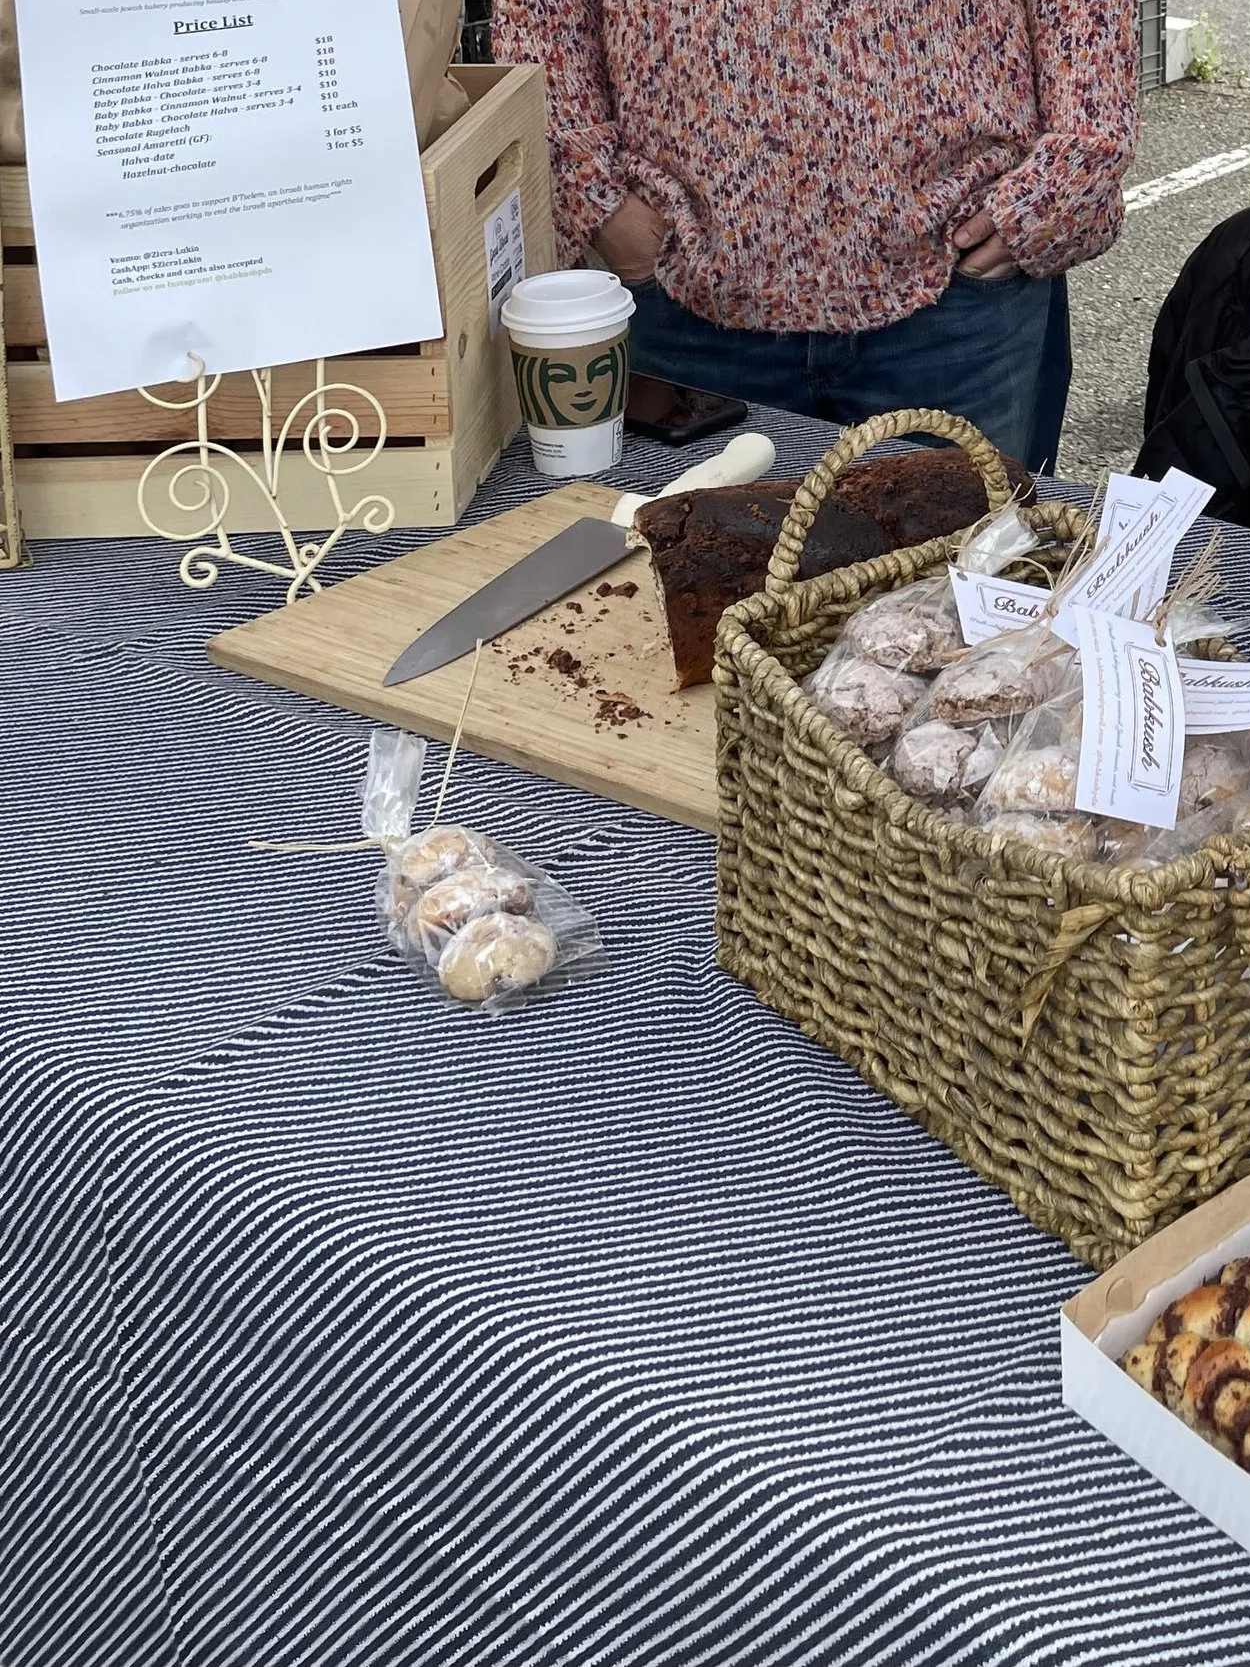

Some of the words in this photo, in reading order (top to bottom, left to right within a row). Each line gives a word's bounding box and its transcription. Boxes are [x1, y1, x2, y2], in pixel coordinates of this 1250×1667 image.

[169, 0, 205, 9] producing
[173, 17, 218, 33] Price
[223, 14, 254, 27] List
[315, 35, 333, 44] $18
[91, 61, 139, 72] Chocolate
[141, 57, 172, 67] Babka
[179, 54, 210, 63] serves
[212, 49, 229, 58] 6-8
[316, 47, 334, 56] $18
[92, 73, 142, 85] Cinnamon
[145, 68, 179, 78] Walnut
[181, 64, 212, 74] Babka
[220, 59, 250, 68] serves
[252, 56, 268, 65] 6-8
[317, 58, 335, 67] $18
[93, 84, 141, 97] Chocolate
[142, 81, 171, 91] Halva
[173, 76, 204, 86] Babka
[212, 71, 242, 81] serves
[244, 68, 261, 77] 6-8
[318, 69, 337, 78] $10
[94, 98, 118, 108] Baby
[121, 95, 152, 105] Babka
[160, 88, 206, 100] Chocolate
[213, 82, 243, 92] serves
[245, 79, 261, 88] 3-4
[319, 80, 338, 89] $10
[94, 110, 119, 120] Baby
[121, 107, 152, 117] Babka
[160, 99, 209, 111] Cinnamon
[212, 93, 246, 104] Walnut
[254, 88, 284, 98] serves
[286, 85, 302, 94] 3-4
[321, 91, 339, 101] $10
[95, 122, 120, 132] Baby
[122, 119, 153, 129] Babka
[161, 111, 208, 123] Chocolate
[210, 105, 238, 116] Halva
[246, 101, 276, 111] serves
[278, 98, 294, 107] 3-4
[322, 104, 333, 113] $1
[335, 100, 358, 111] each
[96, 132, 143, 144] Chocolate
[146, 124, 191, 137] Rugelach
[325, 129, 331, 138] 3
[333, 126, 348, 136] for
[349, 125, 362, 134] $5
[97, 144, 141, 157] Seasonal
[143, 137, 186, 151] Amaretti
[189, 133, 213, 146] (GF):
[327, 142, 333, 151] 3
[335, 140, 349, 149] for
[351, 138, 364, 147] $5
[121, 152, 175, 166] Halva-date
[122, 160, 217, 180] Hazelnut-chocolate
[144, 206, 152, 215] of
[153, 205, 172, 213] sales
[173, 203, 190, 212] goes
[201, 197, 230, 208] support
[304, 181, 329, 191] human
[331, 178, 353, 188] rights
[121, 216, 170, 230] organization
[171, 211, 202, 221] working
[213, 207, 227, 215] end
[229, 205, 241, 213] the
[267, 195, 303, 208] apartheid
[110, 254, 141, 264] Venmo:
[111, 264, 150, 275] CashApp:
[112, 276, 135, 285] Cash,
[136, 271, 165, 282] checks
[166, 269, 183, 278] and
[184, 266, 208, 275] cards
[209, 263, 226, 272] also
[227, 257, 264, 270] accepted
[113, 287, 141, 296] Follow
[1085, 510, 1163, 598] Babkush
[1138, 657, 1163, 771] Babkush
